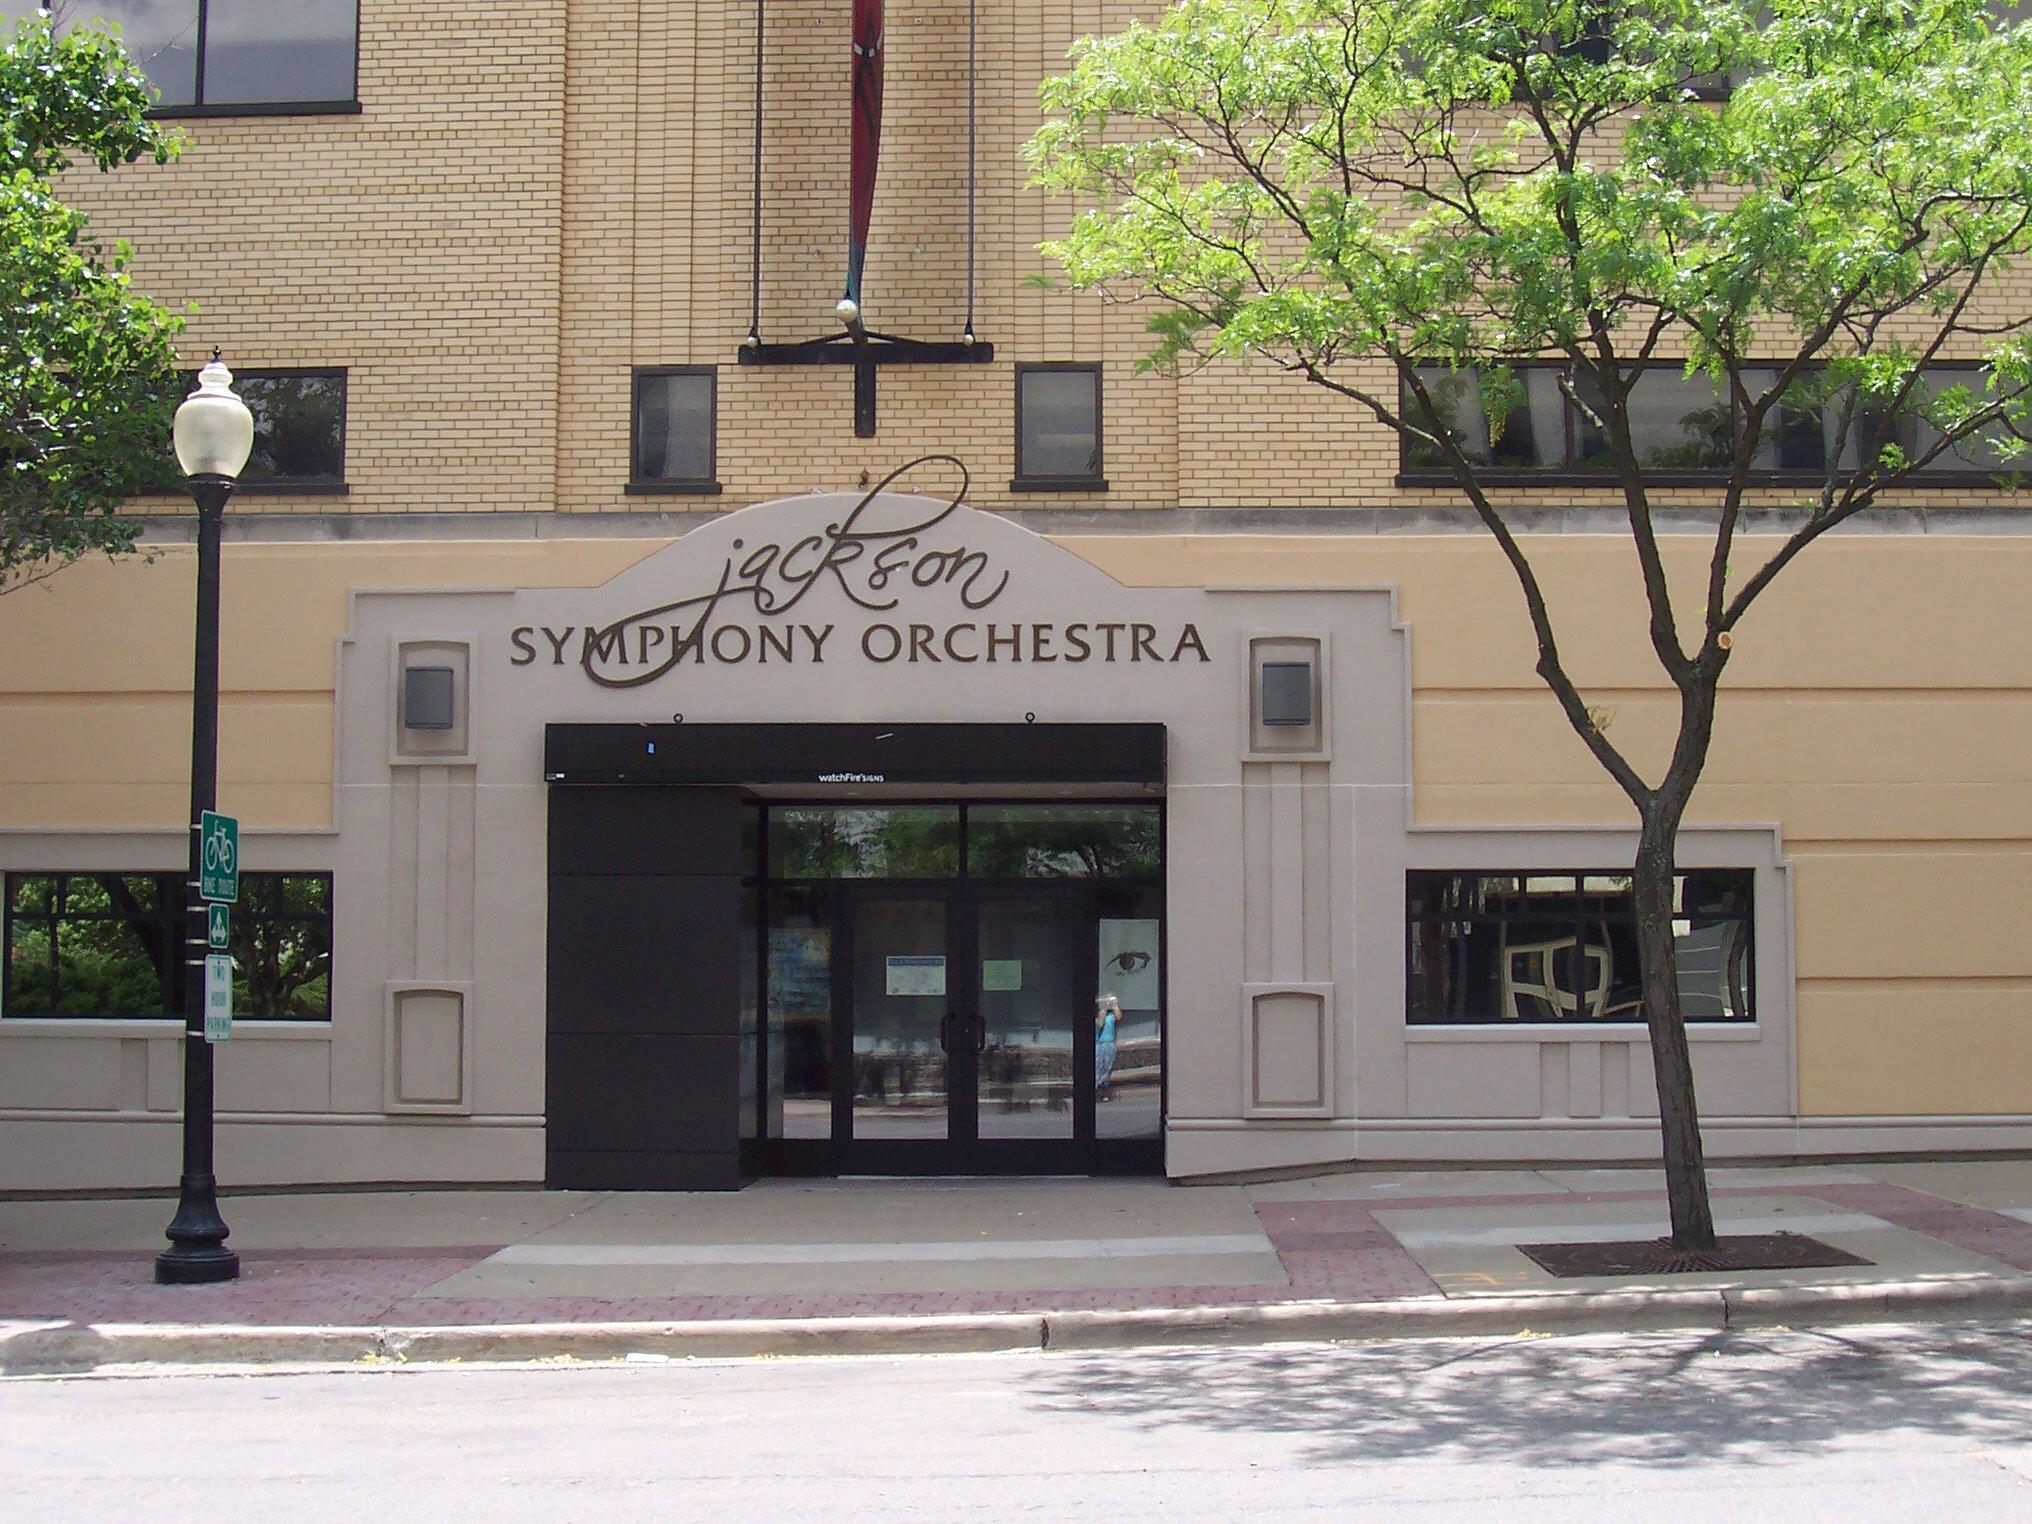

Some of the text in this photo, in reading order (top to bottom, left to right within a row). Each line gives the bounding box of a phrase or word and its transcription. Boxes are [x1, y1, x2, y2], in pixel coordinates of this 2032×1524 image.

[583, 454, 1009, 688] jackson
[510, 623, 1211, 666] SYMPHONY ORCHESTRA
